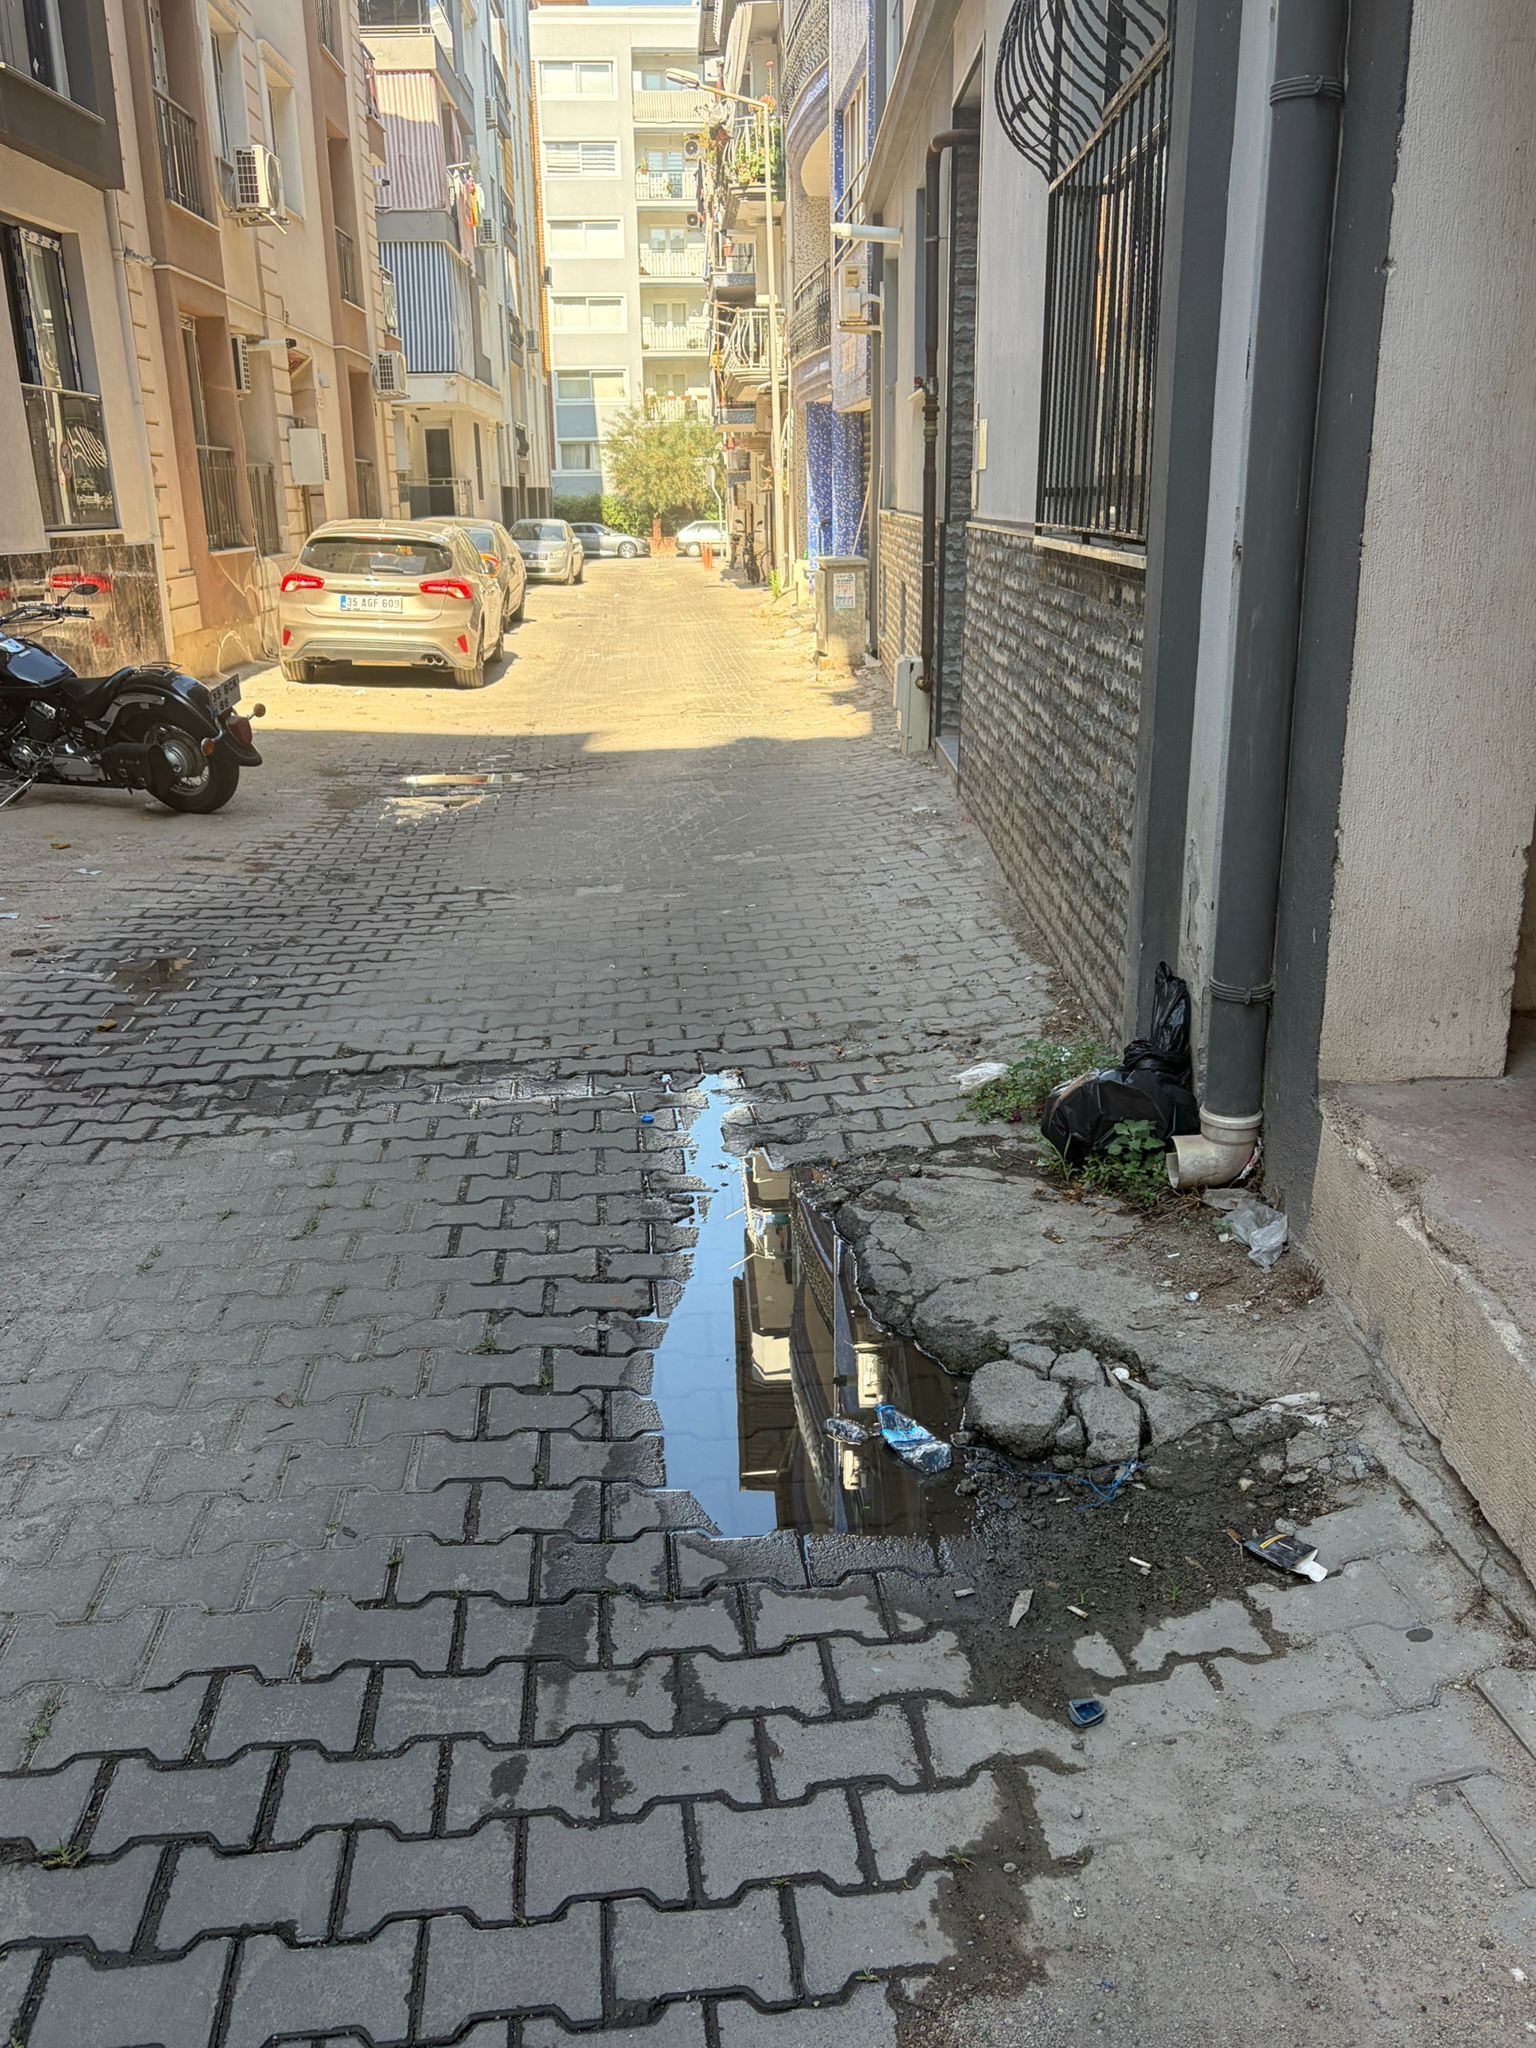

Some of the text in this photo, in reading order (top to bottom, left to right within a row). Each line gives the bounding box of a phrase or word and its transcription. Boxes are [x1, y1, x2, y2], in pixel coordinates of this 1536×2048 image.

[347, 597, 400, 608] 35 AGF 609
